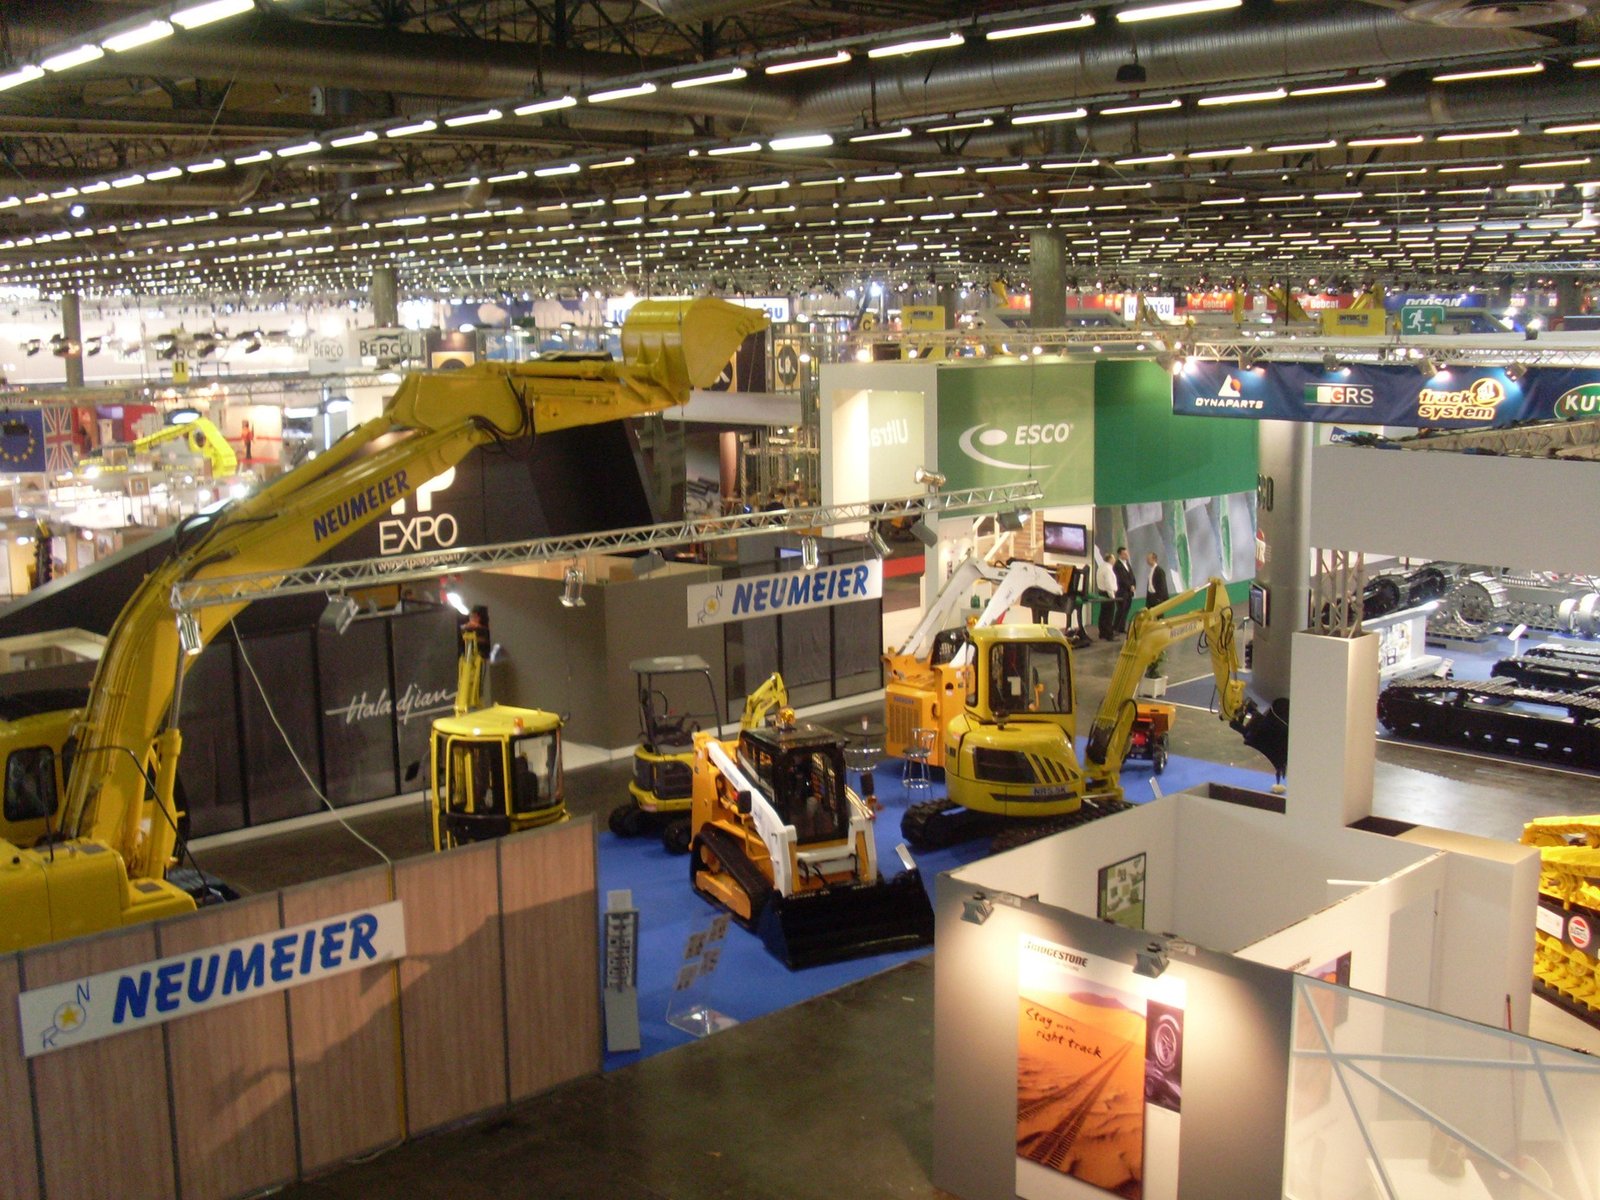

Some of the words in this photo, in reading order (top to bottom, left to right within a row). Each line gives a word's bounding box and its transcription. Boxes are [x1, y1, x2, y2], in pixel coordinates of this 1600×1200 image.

[1203, 299, 1227, 309] Bobcat
[1310, 299, 1339, 309] Bobcat
[313, 342, 344, 358] BERCO
[360, 341, 412, 357] BERCO
[1195, 397, 1264, 410] DYNAPARTS
[1332, 387, 1375, 404] GRS
[1419, 388, 1475, 405] track
[1418, 405, 1495, 420] system
[1014, 422, 1071, 446] ESCO
[312, 469, 411, 544] NEUMEIER
[378, 513, 458, 555] EXPO
[731, 564, 869, 616] NEUMEIER
[326, 683, 457, 726] Haladjian
[112, 913, 379, 1024] NEUMEIER
[1026, 1007, 1053, 1030] Stay
[1036, 1030, 1064, 1045] right
[1068, 1038, 1102, 1059] track
